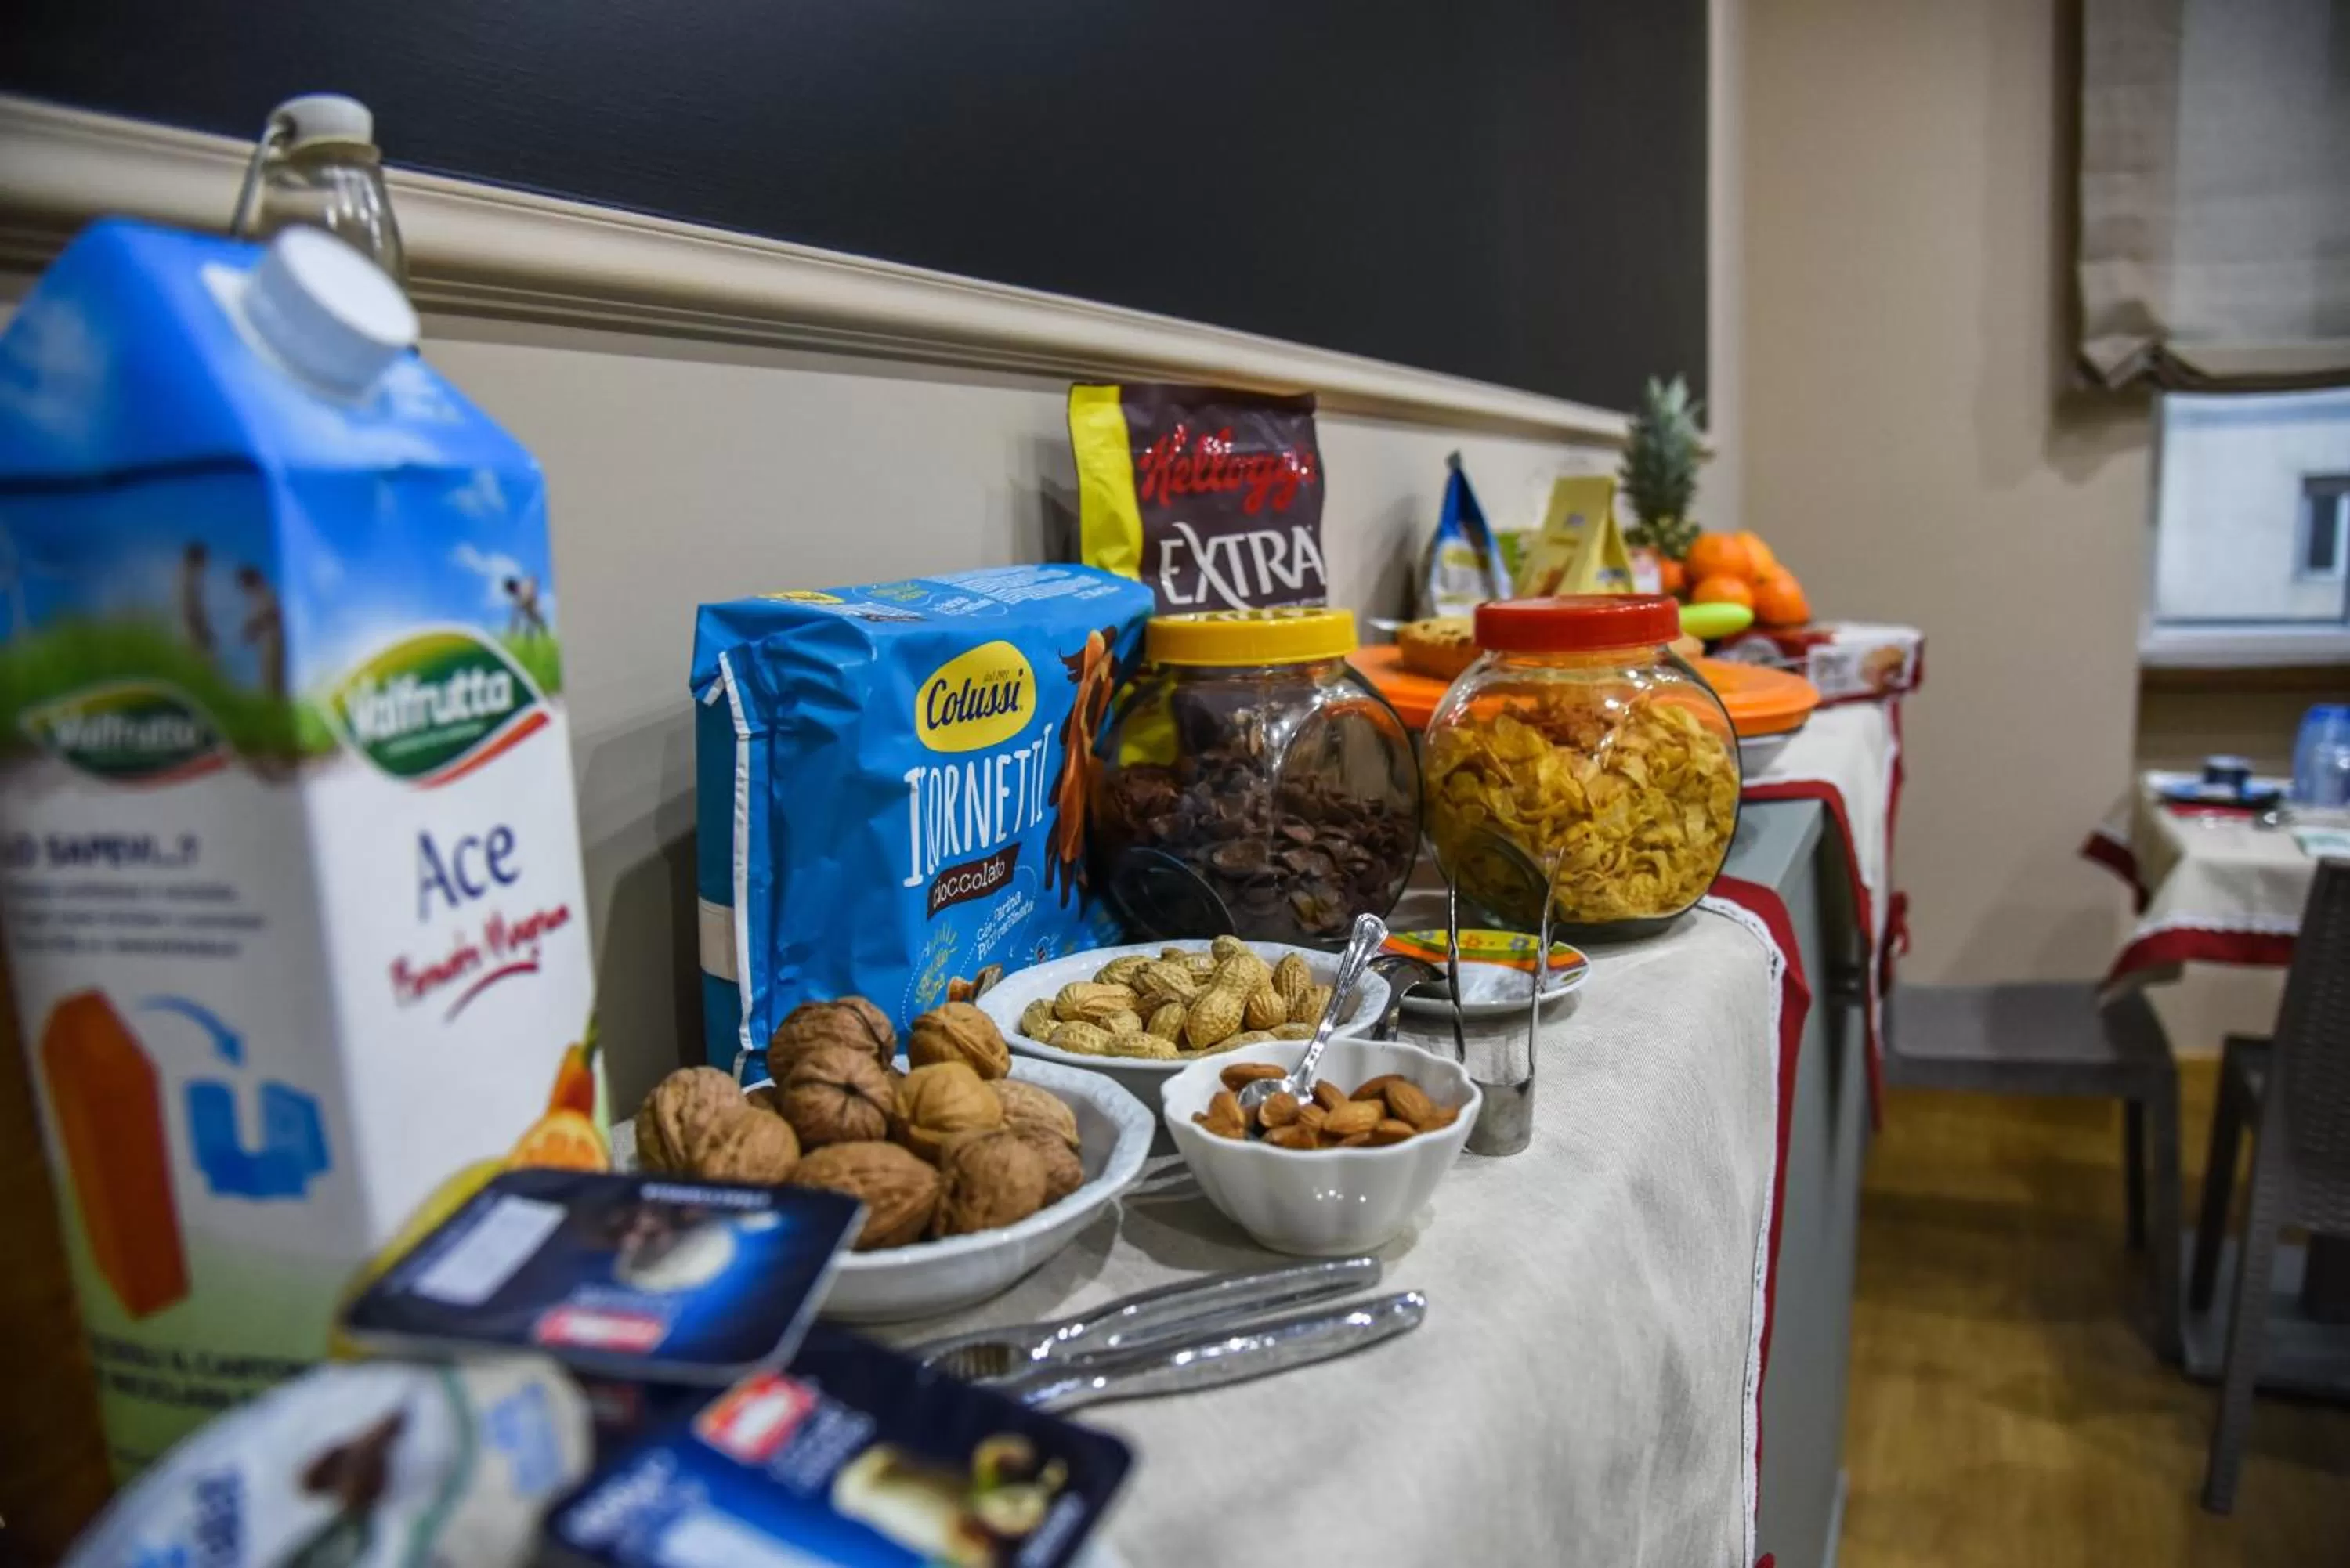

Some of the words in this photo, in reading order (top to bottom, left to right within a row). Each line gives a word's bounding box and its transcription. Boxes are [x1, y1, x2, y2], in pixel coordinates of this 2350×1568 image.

[1159, 521, 1325, 612] EXTRA
[347, 668, 513, 740] Valfrutta
[927, 668, 1024, 730] Colussi
[416, 824, 520, 921] Ace
[932, 856, 1006, 909] cioccolato
